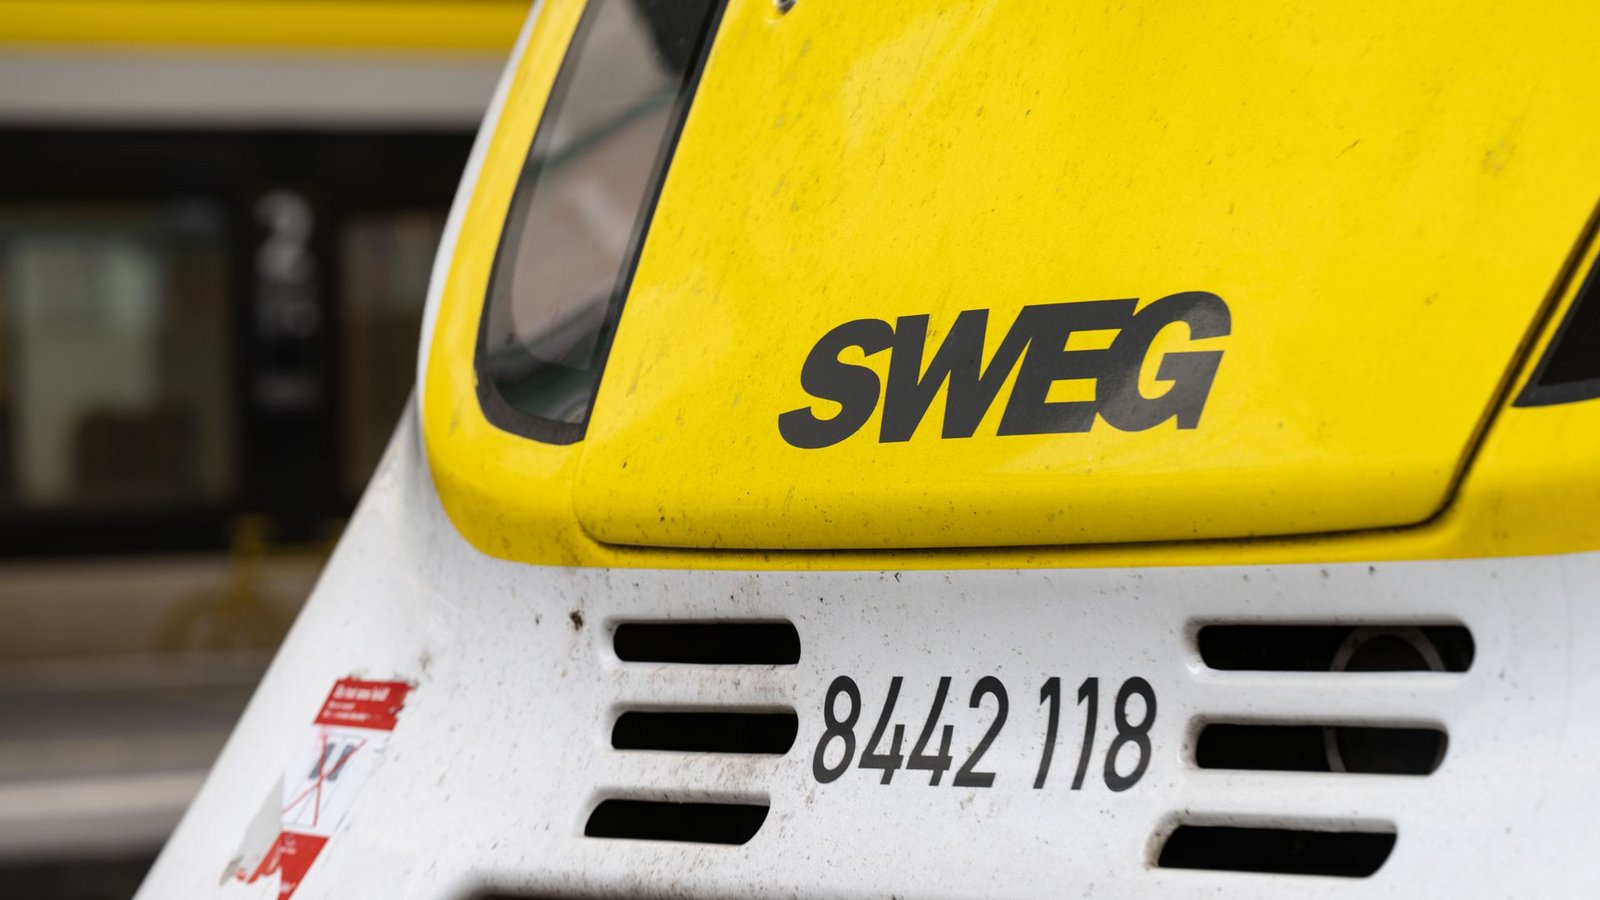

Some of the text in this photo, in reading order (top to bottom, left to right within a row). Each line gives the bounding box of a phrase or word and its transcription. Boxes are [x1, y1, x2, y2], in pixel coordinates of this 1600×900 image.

[778, 291, 1231, 449] SWEG
[813, 676, 1157, 792] 8442 118
